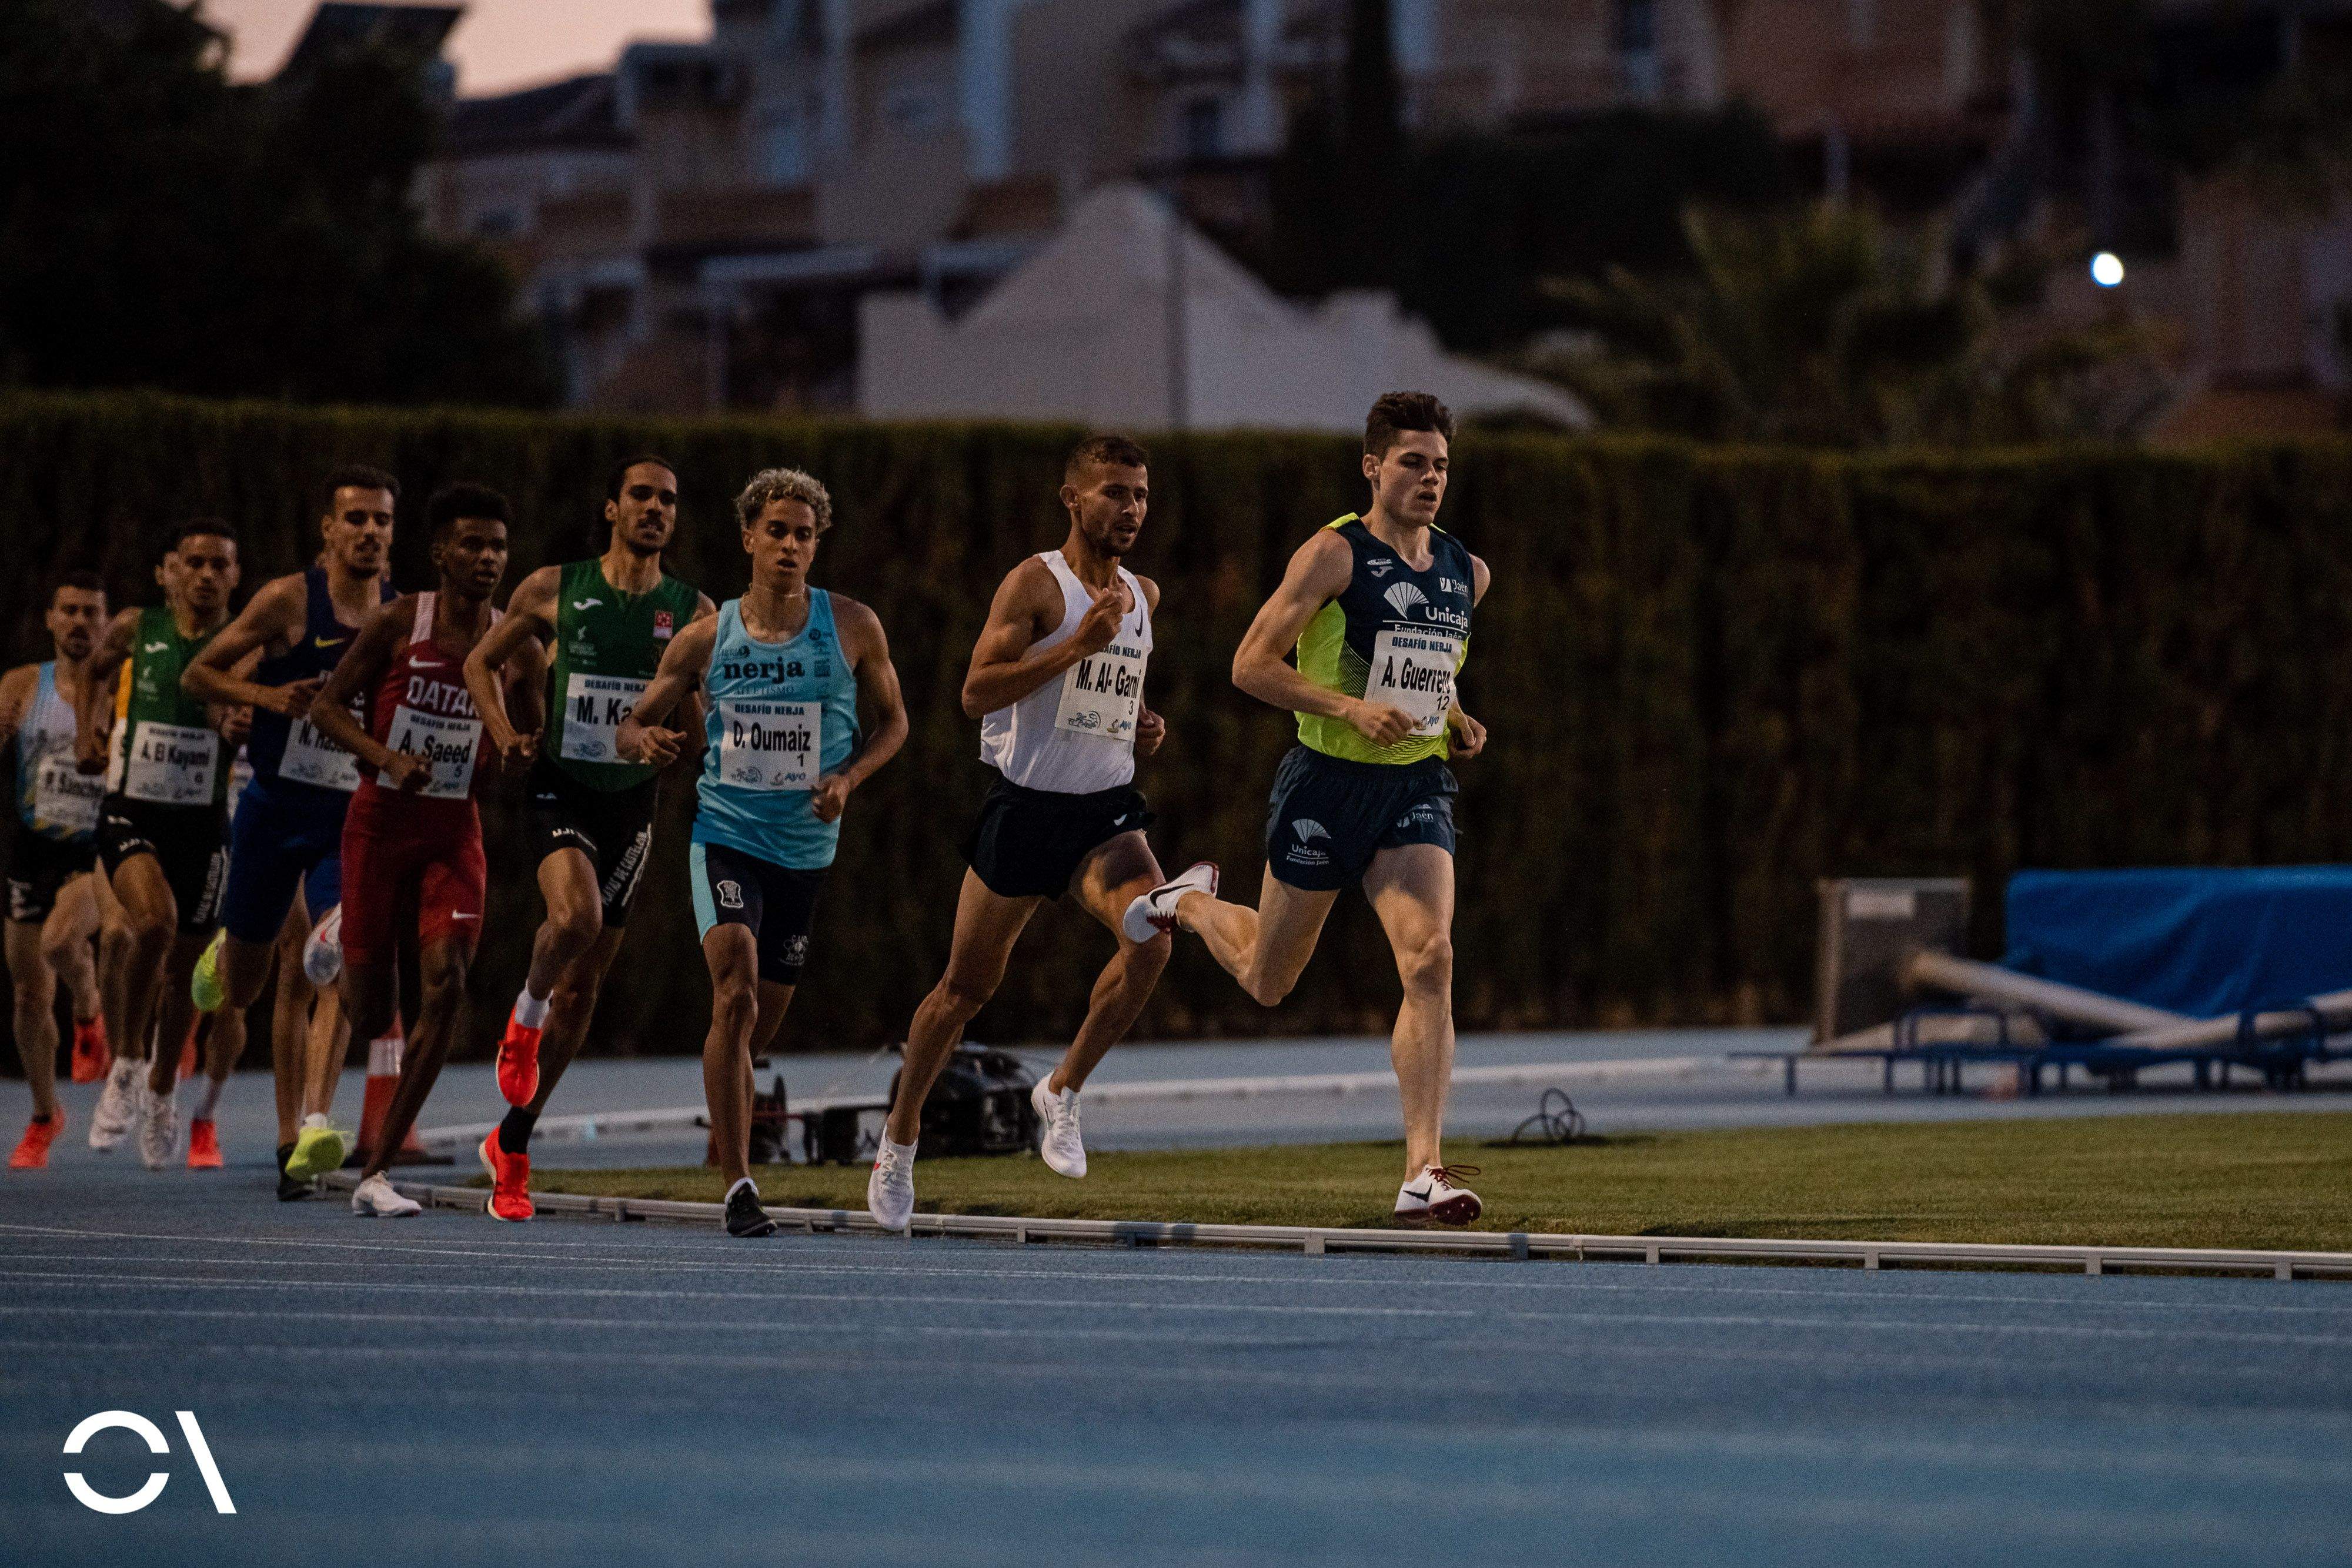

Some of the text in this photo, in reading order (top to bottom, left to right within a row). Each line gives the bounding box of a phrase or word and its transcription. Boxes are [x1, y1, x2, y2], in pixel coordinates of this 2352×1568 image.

[1425, 606, 1468, 629] Unicaja
[1122, 647, 1141, 659] NERJA
[1392, 637, 1452, 653] DESAFÍO NERJA
[723, 656, 805, 684] nerja
[1076, 658, 1092, 690] M.
[1115, 665, 1141, 698] Garni
[1381, 656, 1451, 694] A. Guerrero
[624, 682, 646, 693] NERJ
[577, 695, 599, 724] M.
[735, 704, 804, 716] DESAFÍO NERJA
[1128, 700, 1134, 716] 3
[1437, 696, 1450, 711] 12
[733, 720, 811, 751] D. Oumaiz
[423, 735, 472, 764] Saeed
[797, 753, 804, 767] 1
[1291, 843, 1327, 858] Unicaja
